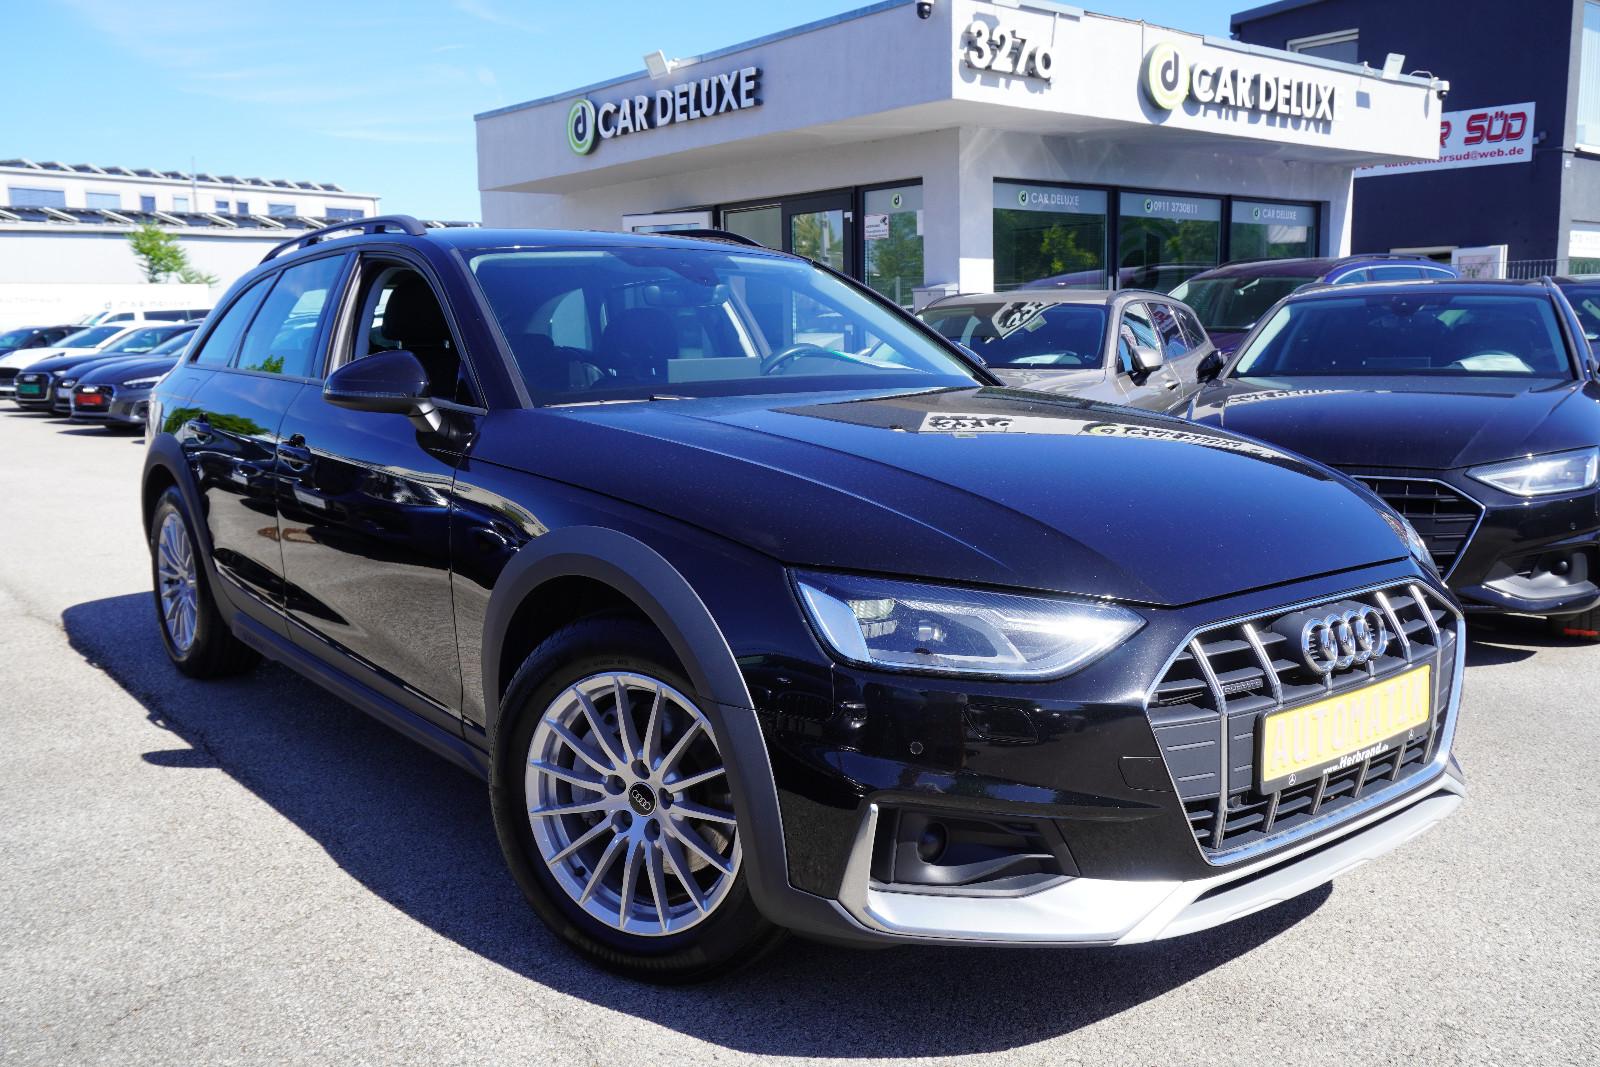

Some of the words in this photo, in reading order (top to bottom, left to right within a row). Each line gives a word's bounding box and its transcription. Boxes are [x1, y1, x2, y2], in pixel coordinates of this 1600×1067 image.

[598, 95, 648, 138] CAR
[656, 66, 757, 127] DELUXE
[1193, 62, 1252, 108] CAR
[1463, 111, 1527, 146] SÜD
[1031, 192, 1049, 204] CAR
[1050, 193, 1080, 206] DELUXE
